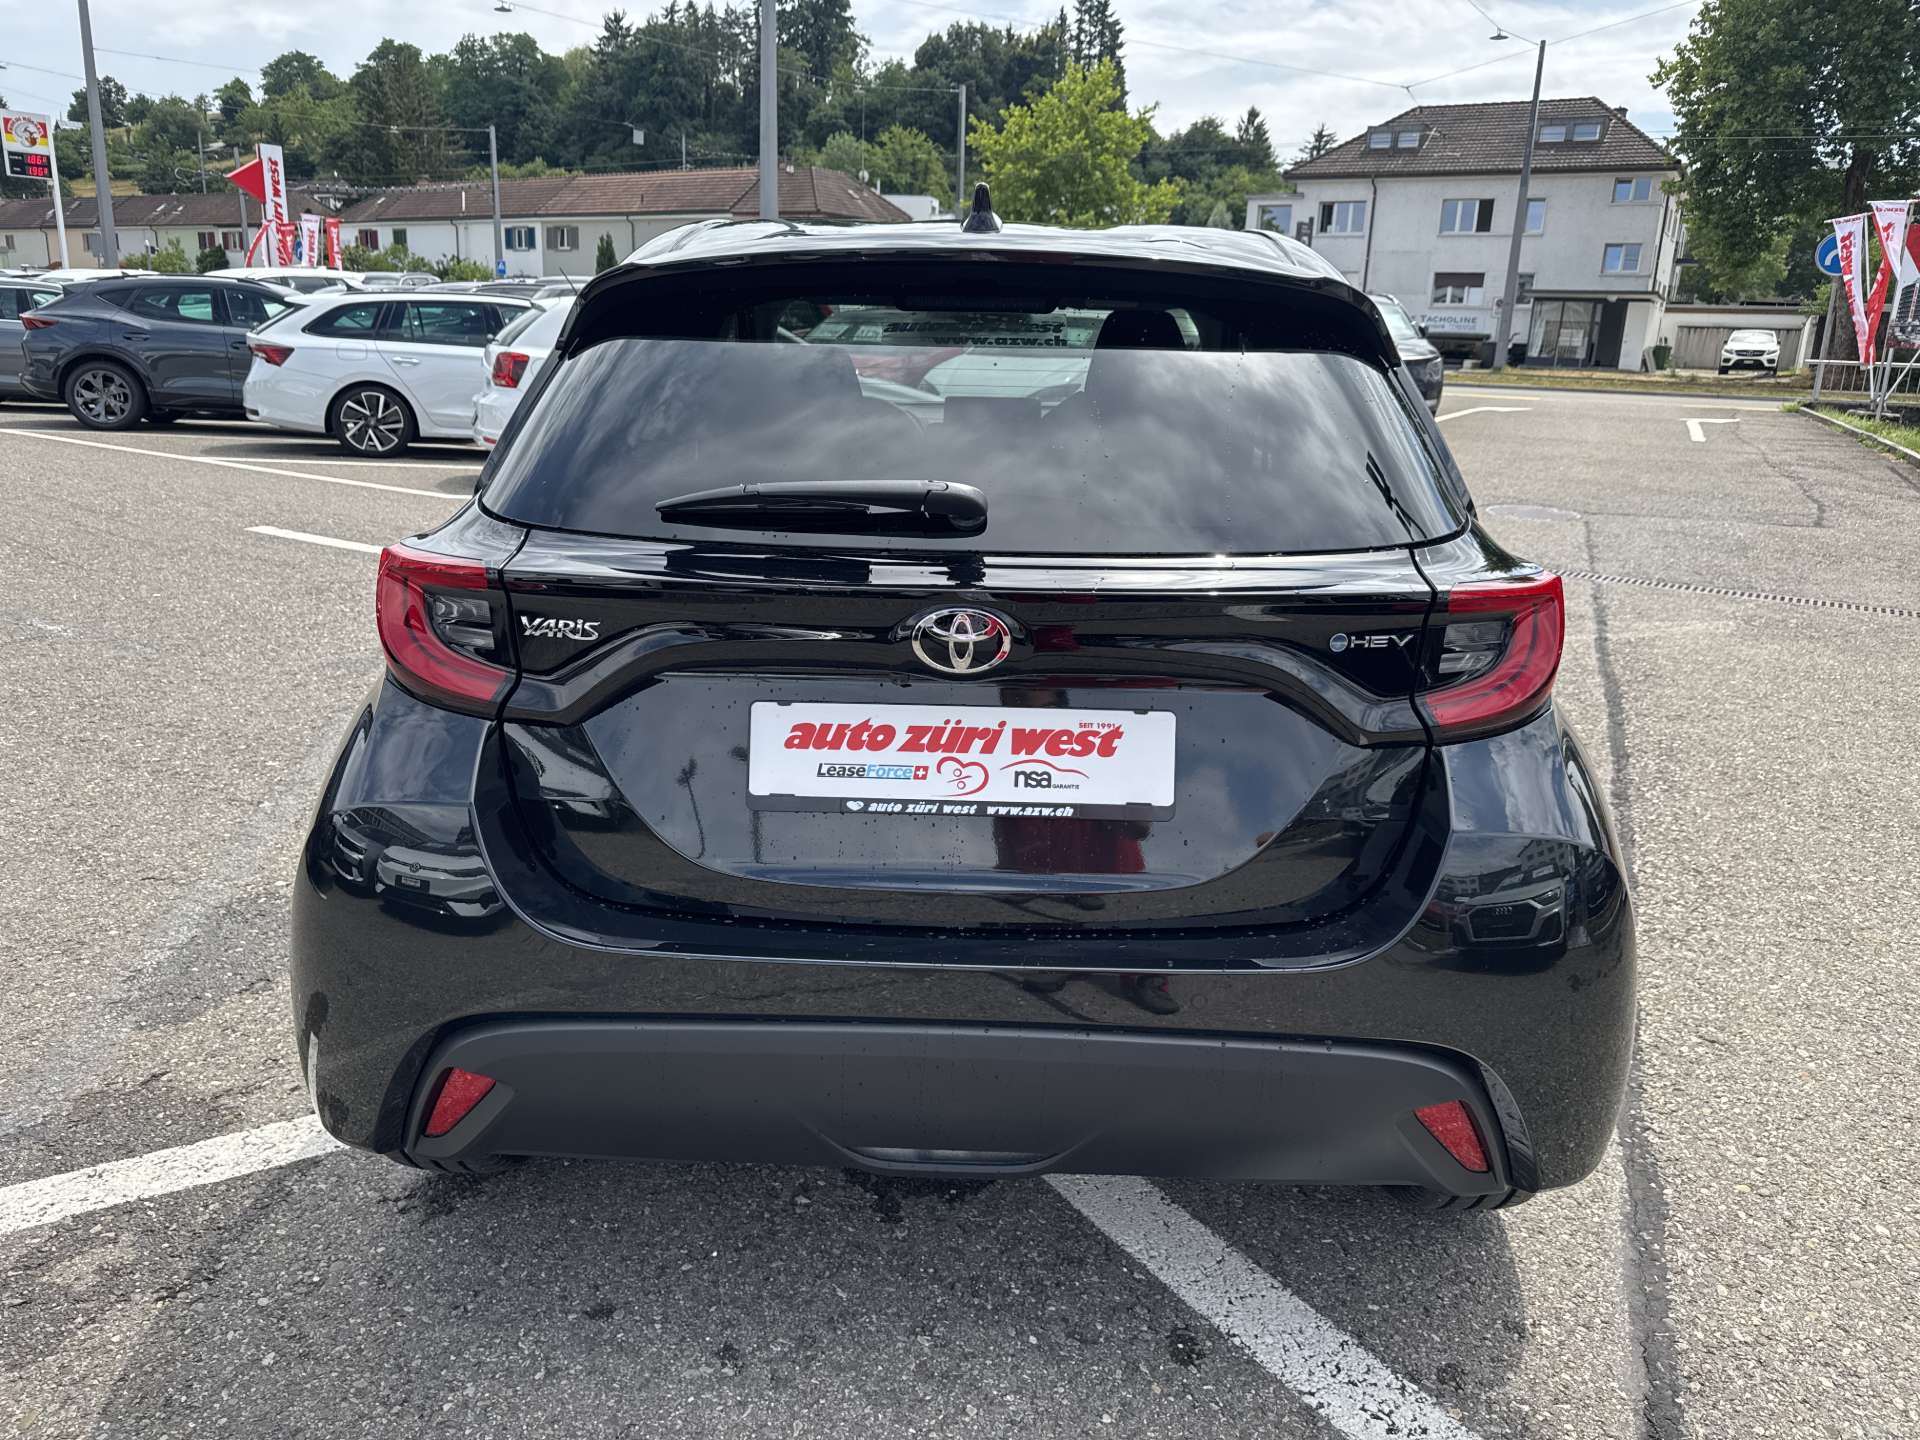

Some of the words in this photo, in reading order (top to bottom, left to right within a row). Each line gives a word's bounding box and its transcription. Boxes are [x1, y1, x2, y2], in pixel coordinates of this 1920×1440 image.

[268, 157, 282, 198] west
[931, 334, 1068, 347] www.azw.ch
[1350, 634, 1414, 648] HEV
[784, 717, 896, 752] auto
[897, 718, 1007, 755] züri
[1011, 723, 1124, 758] west
[816, 762, 914, 779] LeaseForce
[1013, 770, 1052, 789] nsa
[868, 801, 902, 813] auto
[905, 802, 939, 814] züri
[943, 803, 977, 815] west
[986, 805, 1075, 817] www.azw.ch
